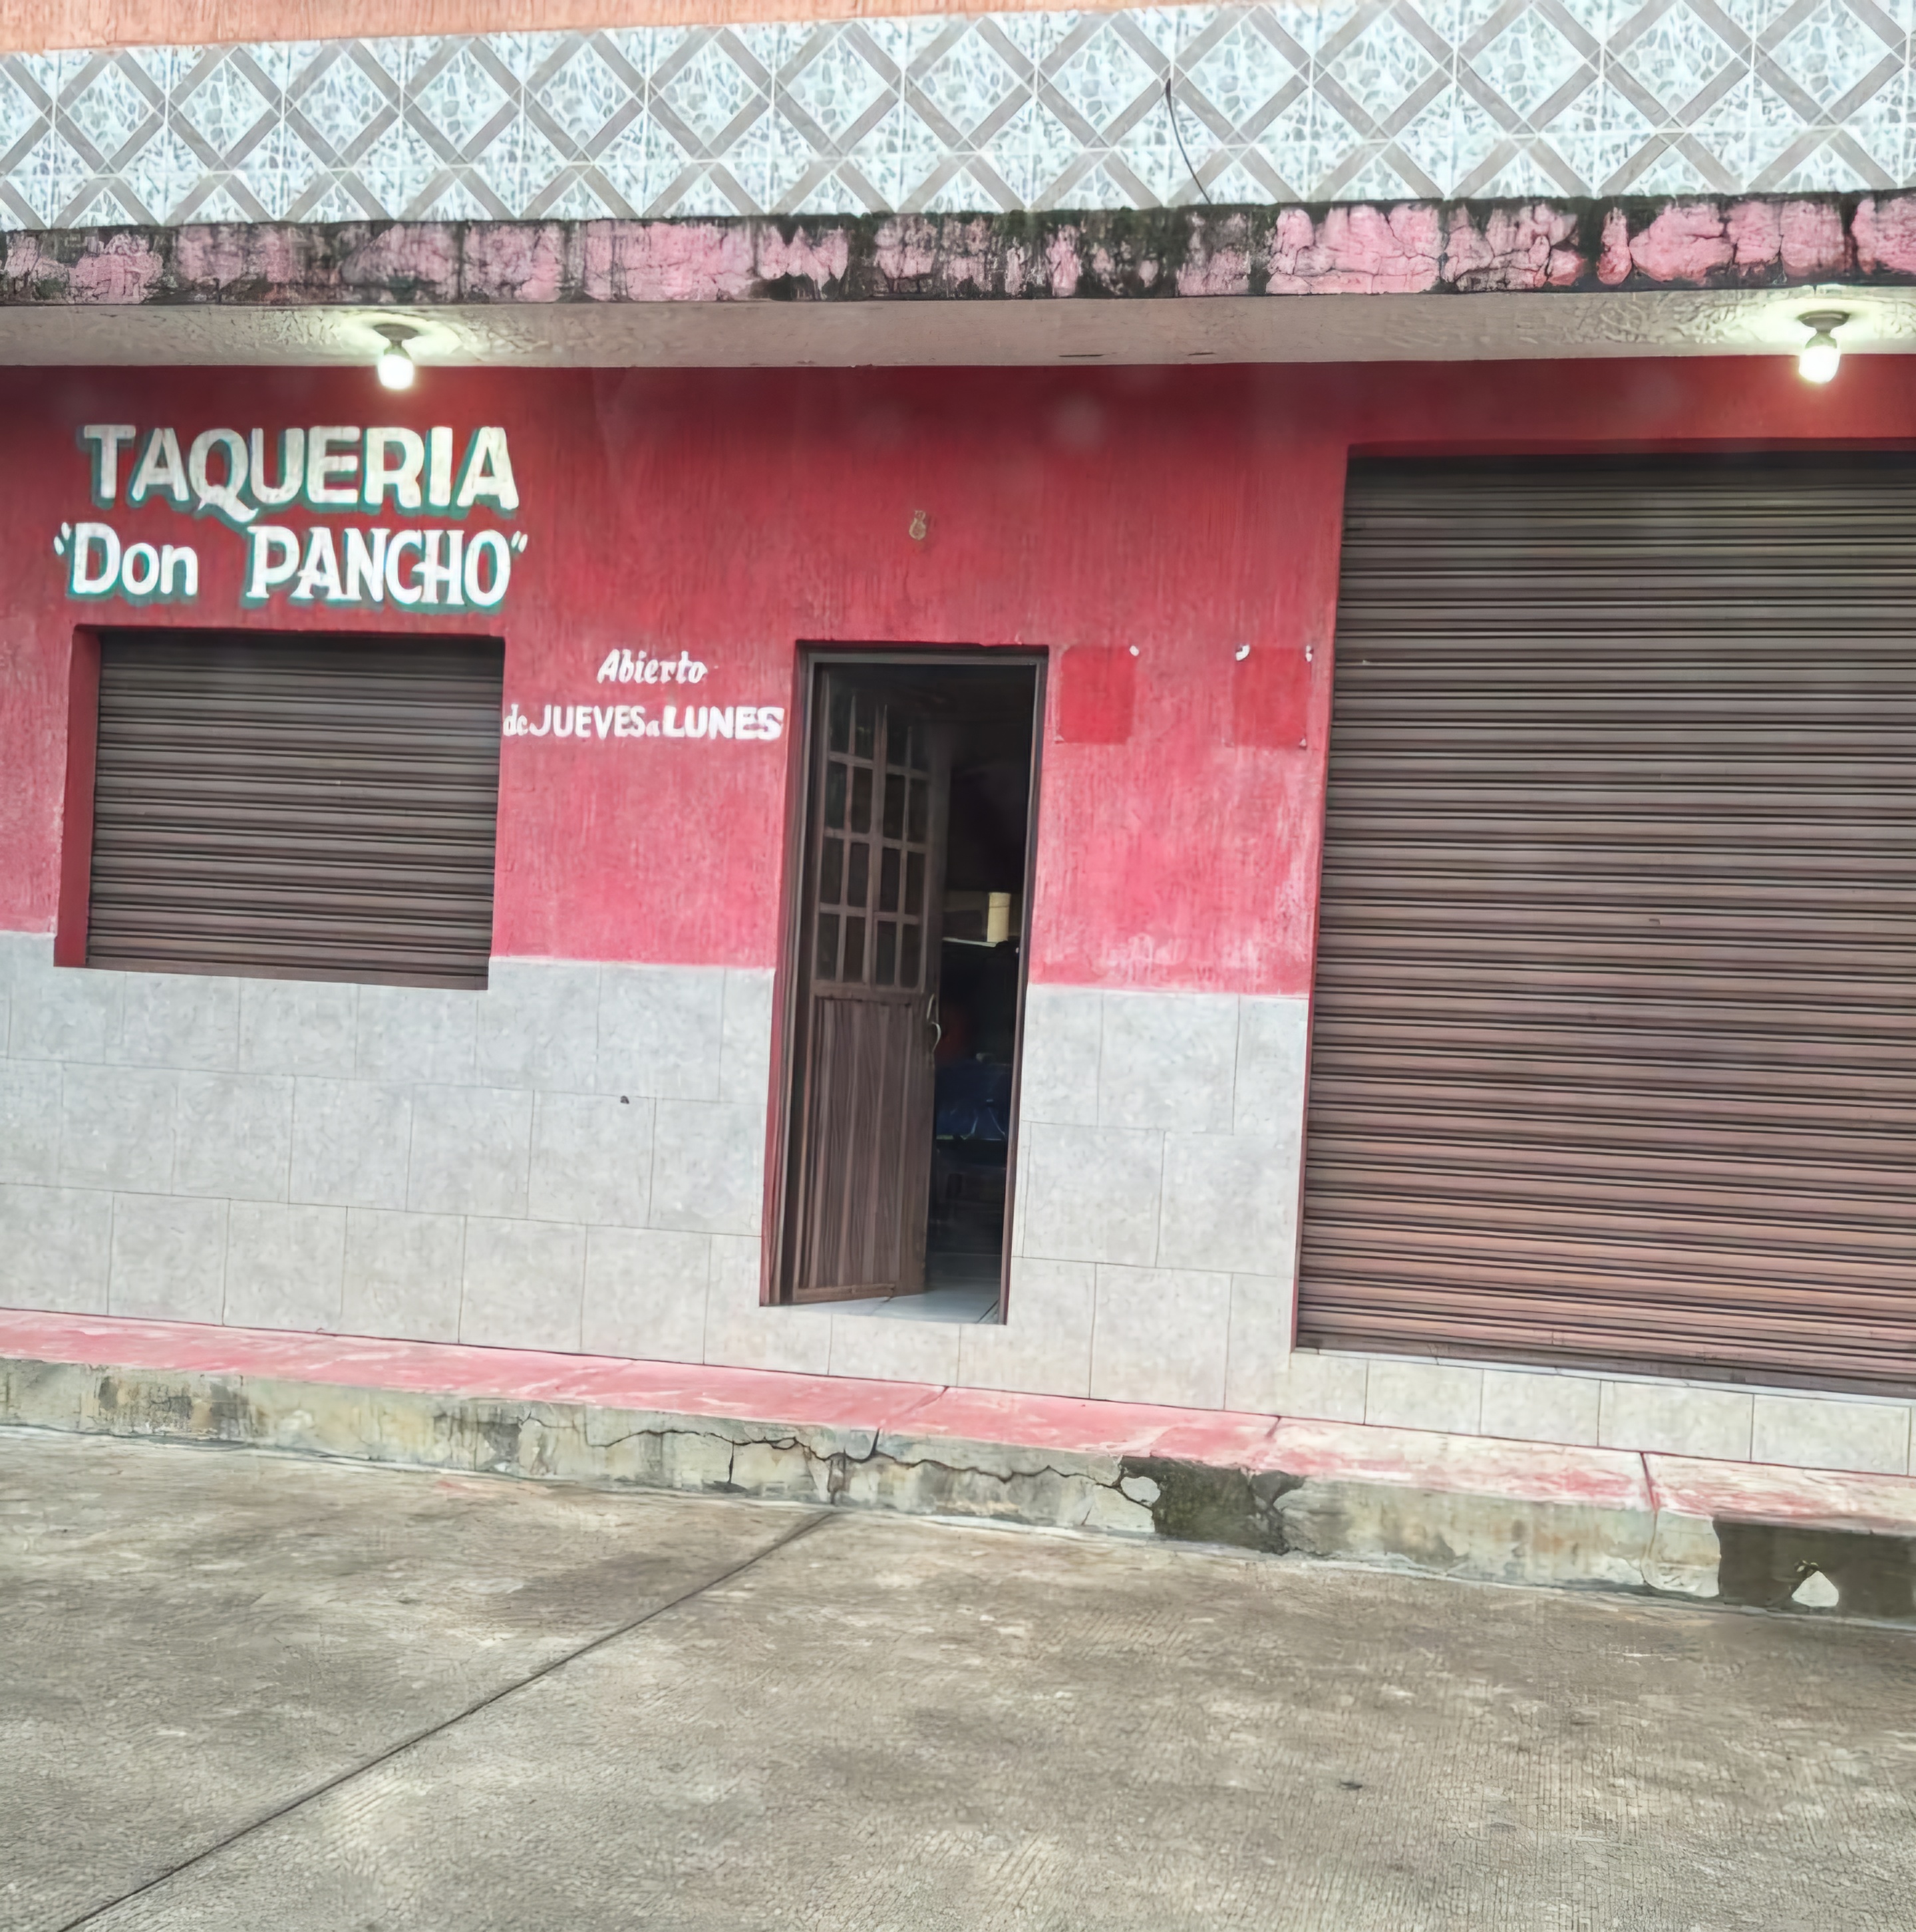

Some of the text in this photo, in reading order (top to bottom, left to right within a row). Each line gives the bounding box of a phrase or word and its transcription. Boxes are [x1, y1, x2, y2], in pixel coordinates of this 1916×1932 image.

[82, 424, 520, 523] TAQUERIA
[596, 648, 709, 684] Abierto
[528, 703, 646, 740] JUEVES
[645, 720, 660, 737] a
[662, 705, 785, 740] LUNES
